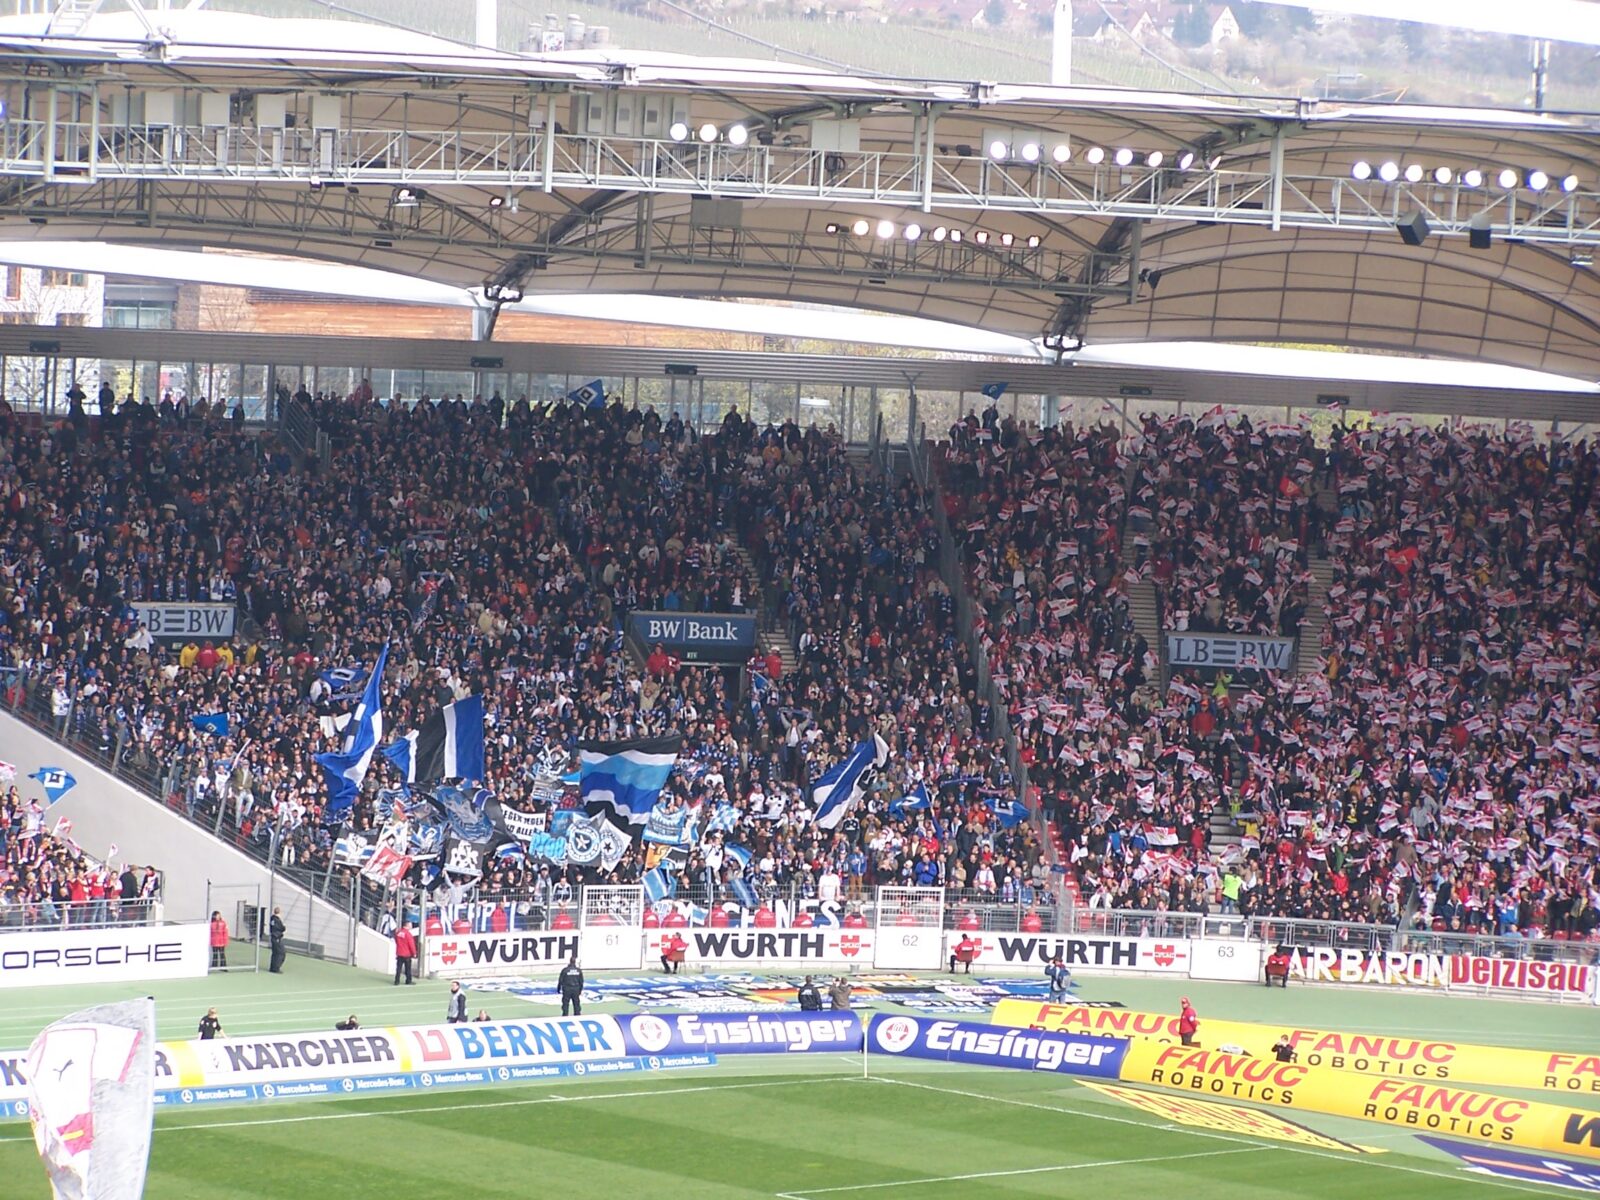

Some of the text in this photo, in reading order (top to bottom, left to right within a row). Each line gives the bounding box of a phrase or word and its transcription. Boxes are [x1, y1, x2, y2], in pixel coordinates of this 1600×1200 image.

[649, 620, 738, 640] BW Bank
[468, 934, 579, 963] WÜRTH
[606, 935, 619, 946] 61
[694, 932, 823, 959] WÜRTH
[902, 934, 919, 947] 62
[999, 937, 1137, 966] WÜRTH
[1218, 946, 1234, 958] 63
[454, 1020, 611, 1060] BERNER
[677, 1015, 852, 1051] Ensinger
[926, 1021, 1116, 1069] Ensinger
[1290, 1030, 1456, 1062] FANUC
[224, 1036, 395, 1072] KÄRCHER
[1156, 1046, 1308, 1087] FANUC
[1290, 1052, 1449, 1078] ROBOTICS
[1152, 1069, 1293, 1104] ROBOTICS
[1368, 1079, 1528, 1123] FANUC
[1364, 1103, 1515, 1141] ROBOTICS
